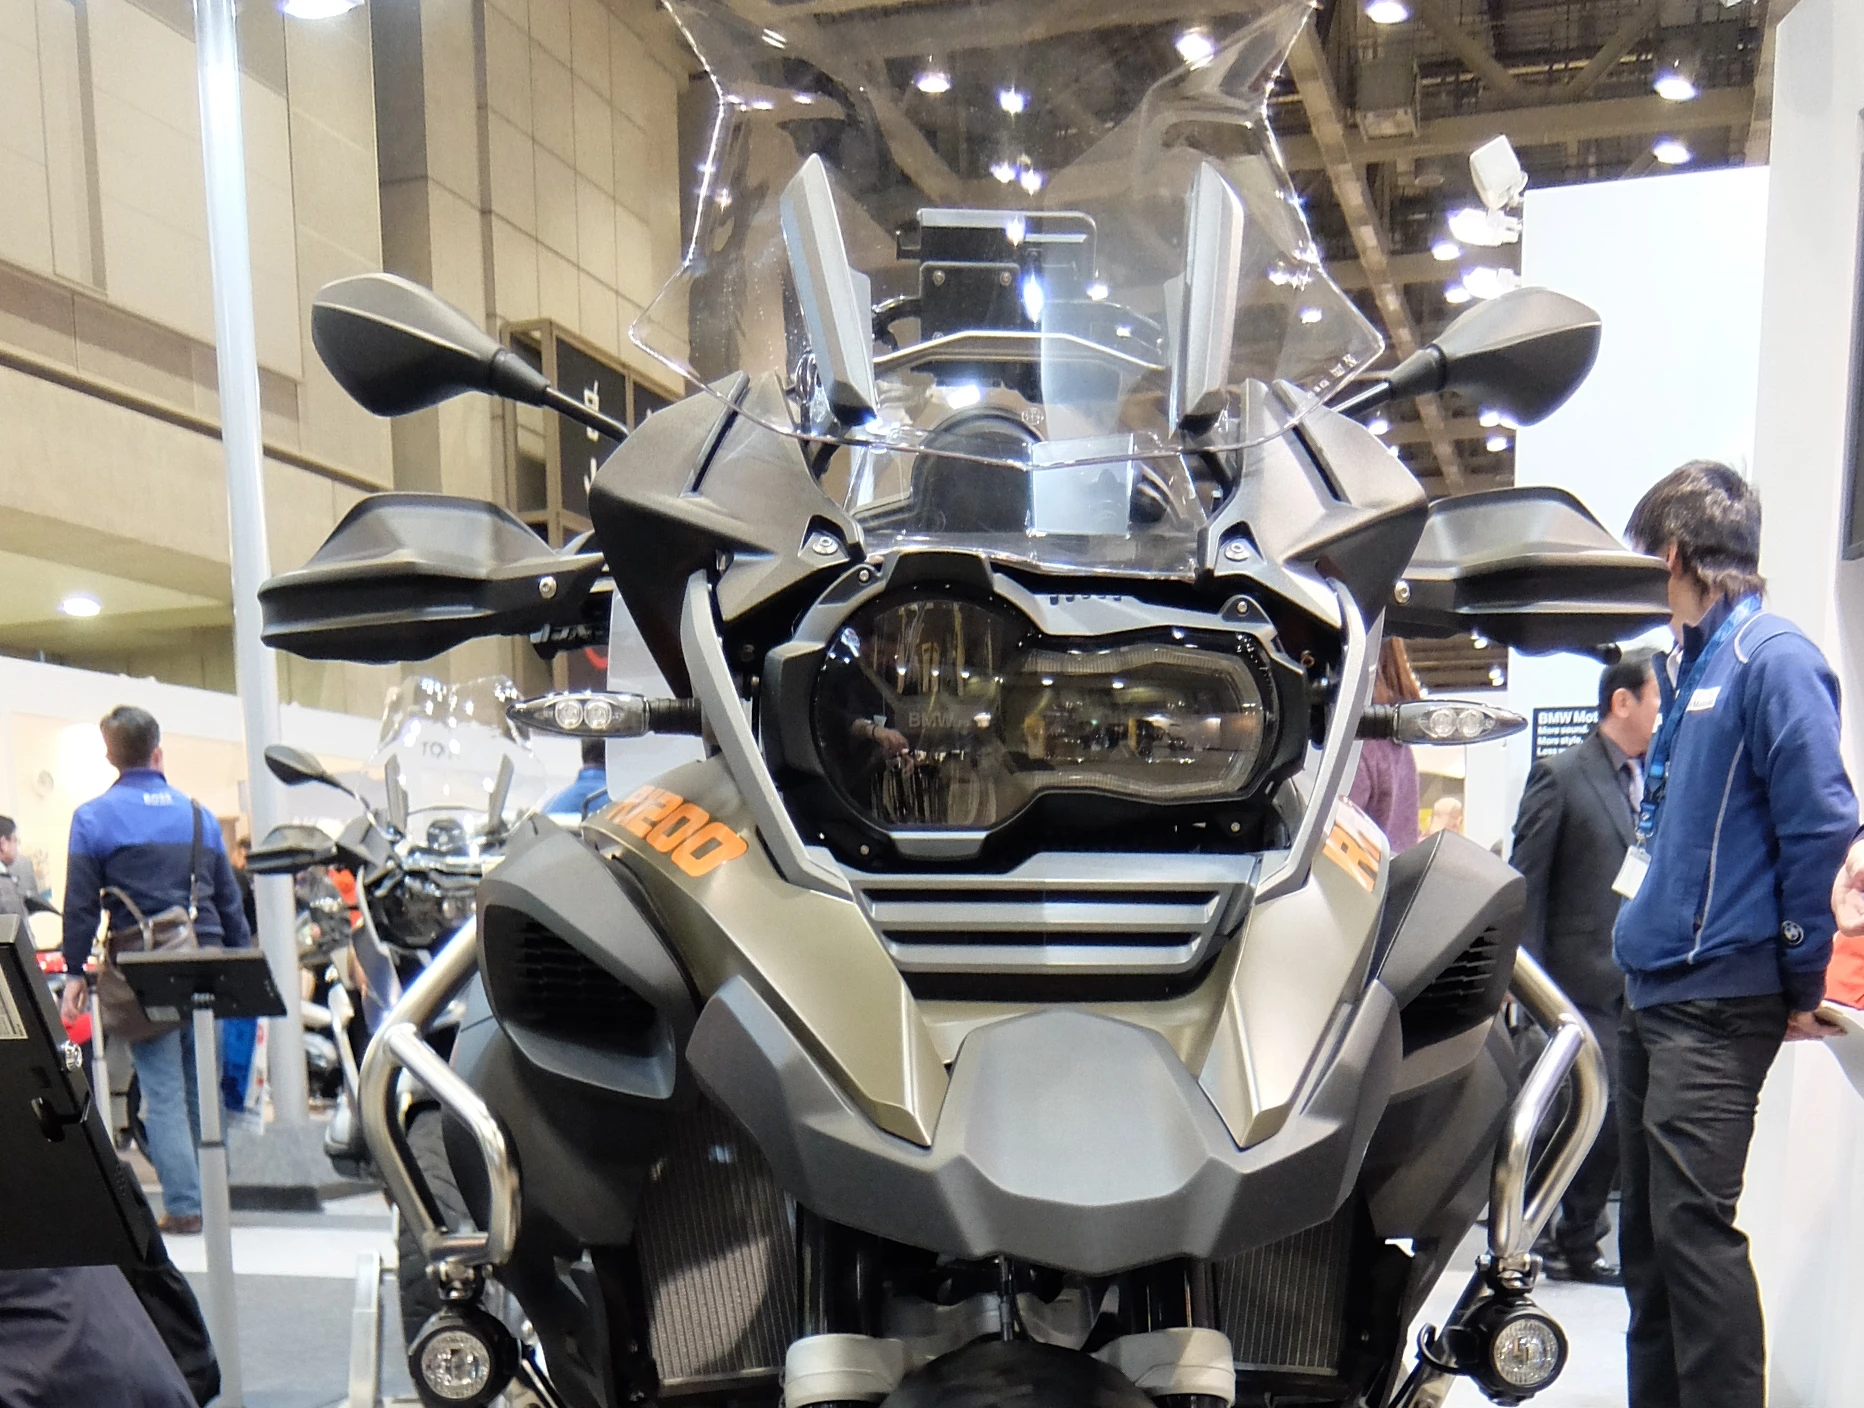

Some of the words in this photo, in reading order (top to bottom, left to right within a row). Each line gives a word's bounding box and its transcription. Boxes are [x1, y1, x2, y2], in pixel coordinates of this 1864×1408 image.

[908, 711, 955, 728] BMW
[1537, 711, 1572, 725] BMW
[1573, 709, 1599, 725] Mot
[1537, 725, 1560, 735] More
[1536, 736, 1560, 746] More
[605, 784, 748, 877] R1200
